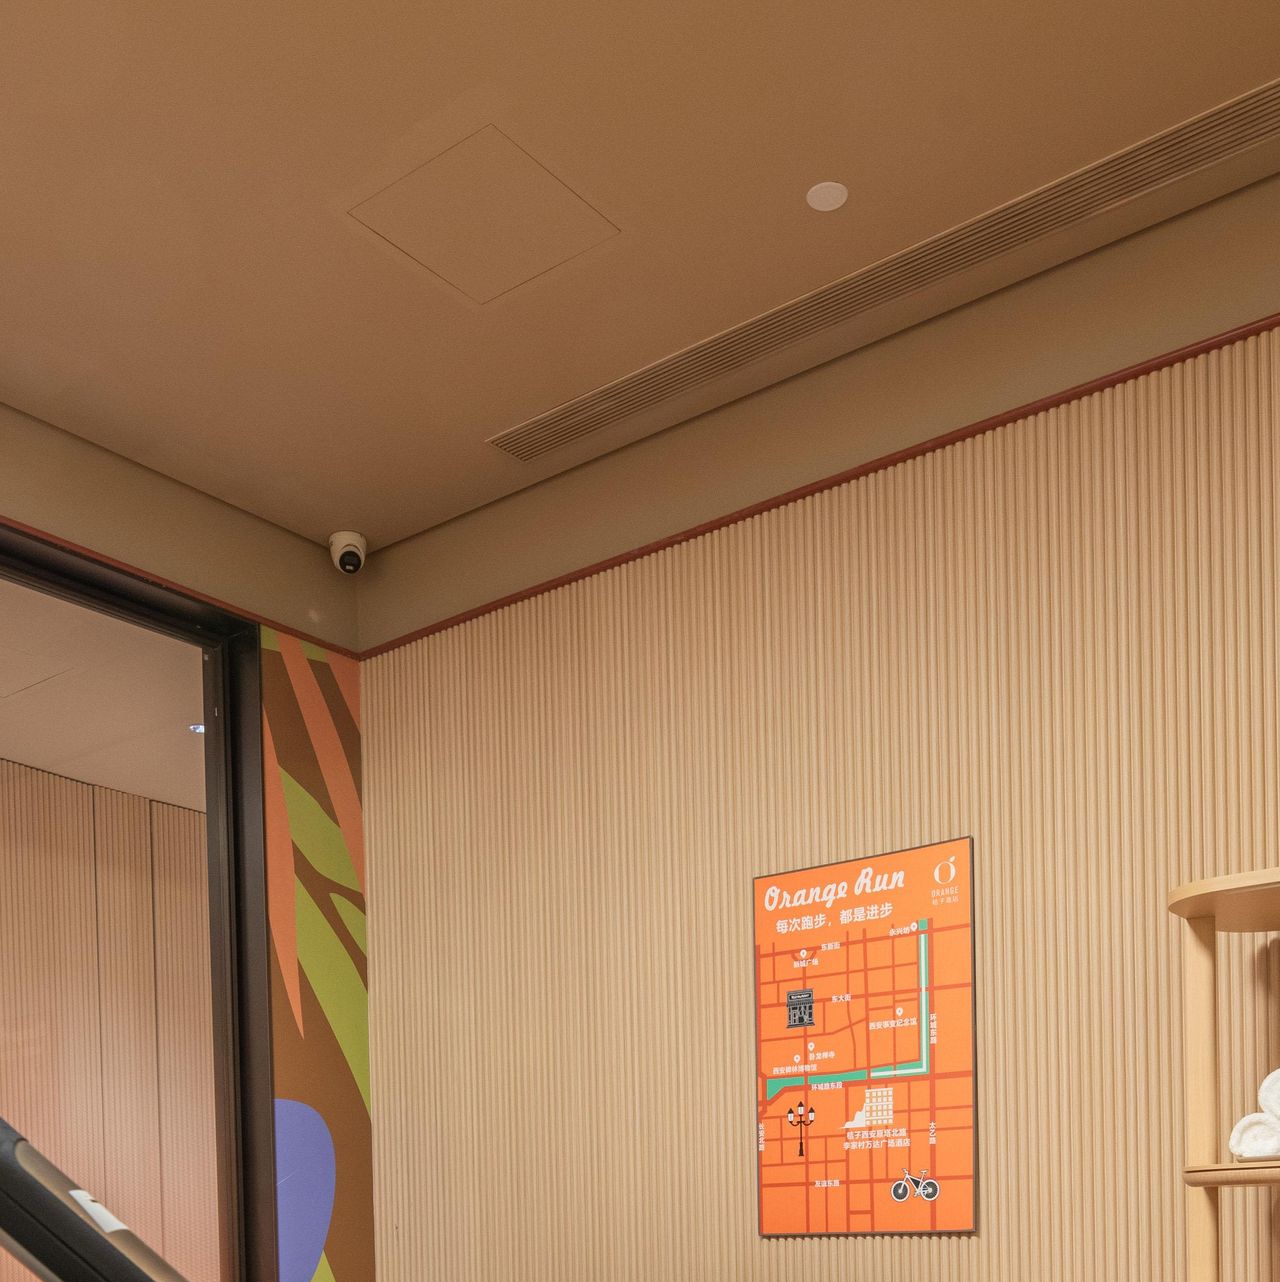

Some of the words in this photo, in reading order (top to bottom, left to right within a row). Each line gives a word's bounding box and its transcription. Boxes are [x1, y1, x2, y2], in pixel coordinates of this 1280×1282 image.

[764, 881, 848, 911] Orange
[854, 867, 905, 895] Run
[931, 886, 960, 898] ORANGE
